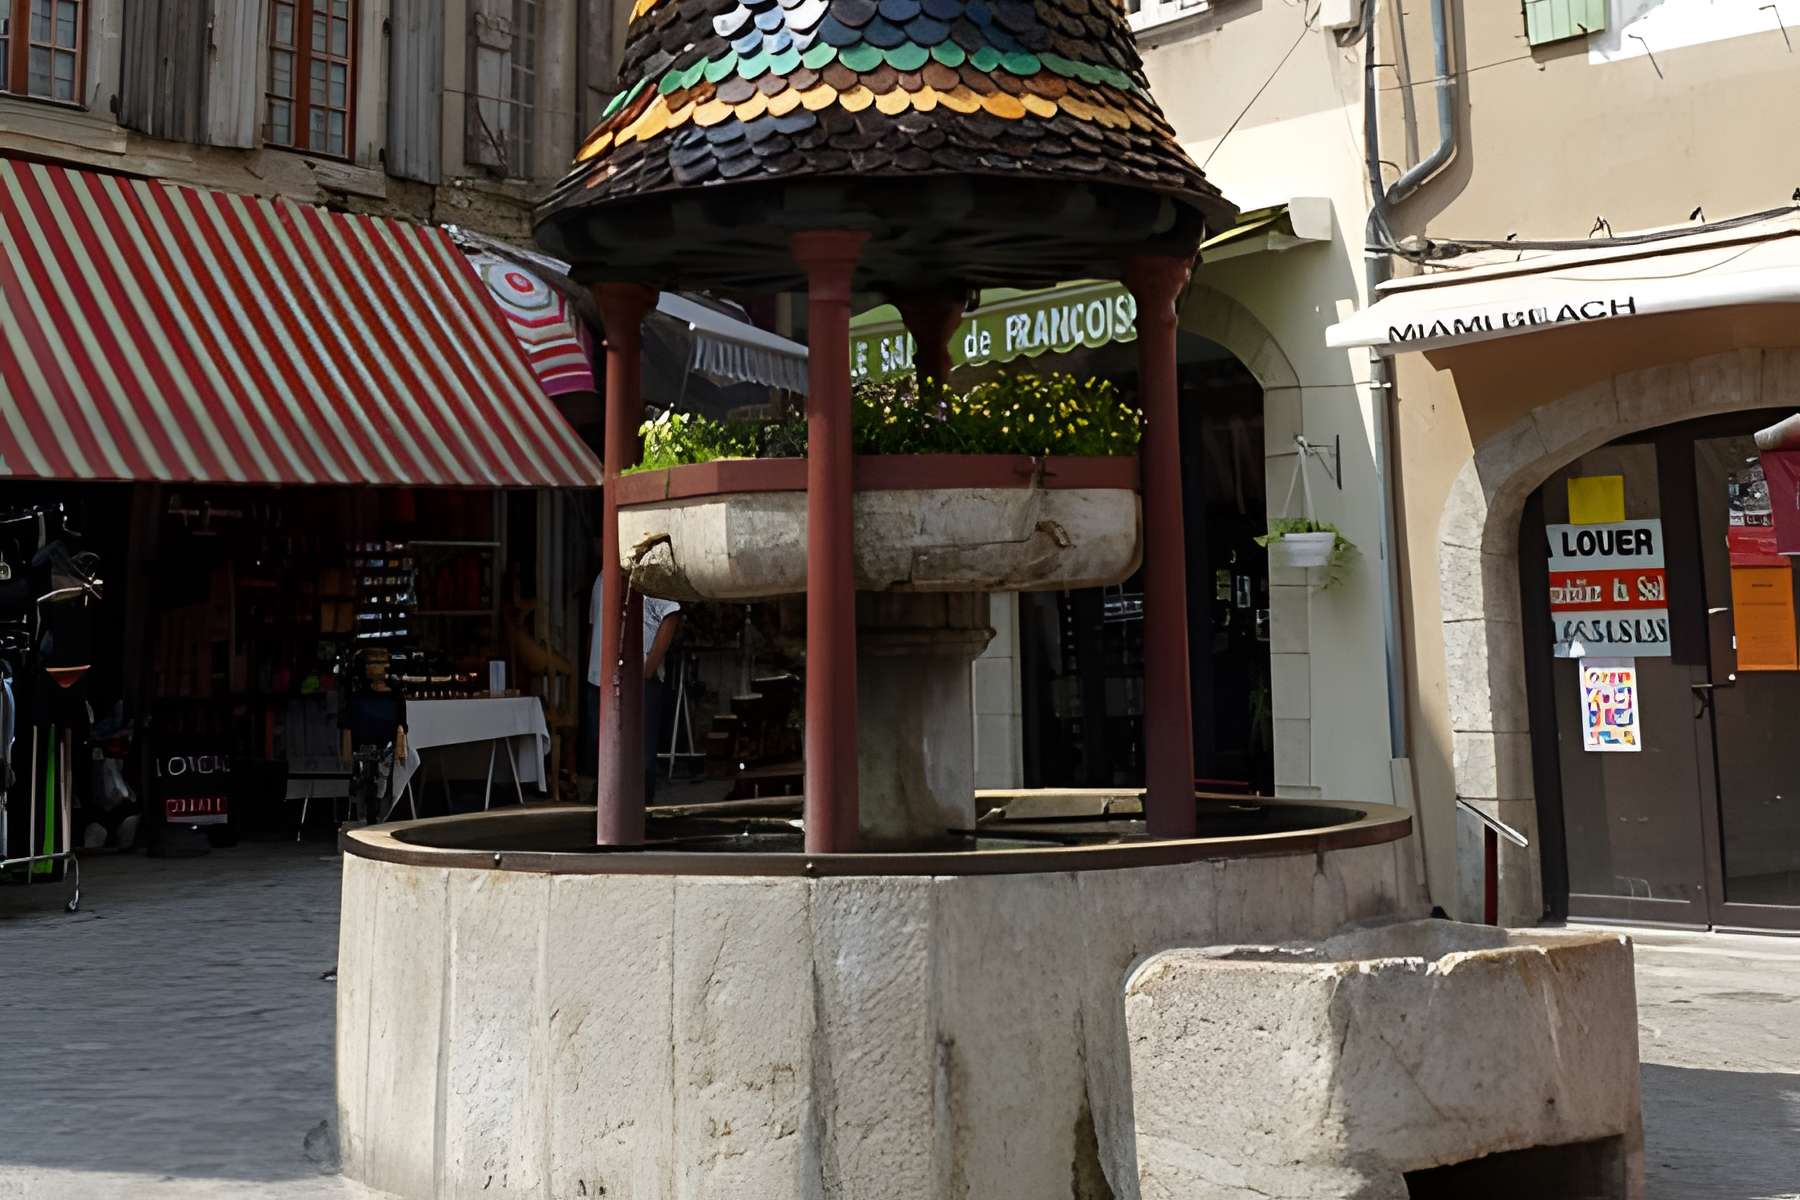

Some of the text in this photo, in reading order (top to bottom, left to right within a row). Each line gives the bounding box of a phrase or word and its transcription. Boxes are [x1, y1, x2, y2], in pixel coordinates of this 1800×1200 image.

[963, 318, 991, 359] de
[1388, 314, 1493, 344] MIAMI
[1561, 528, 1654, 557] LOUER
